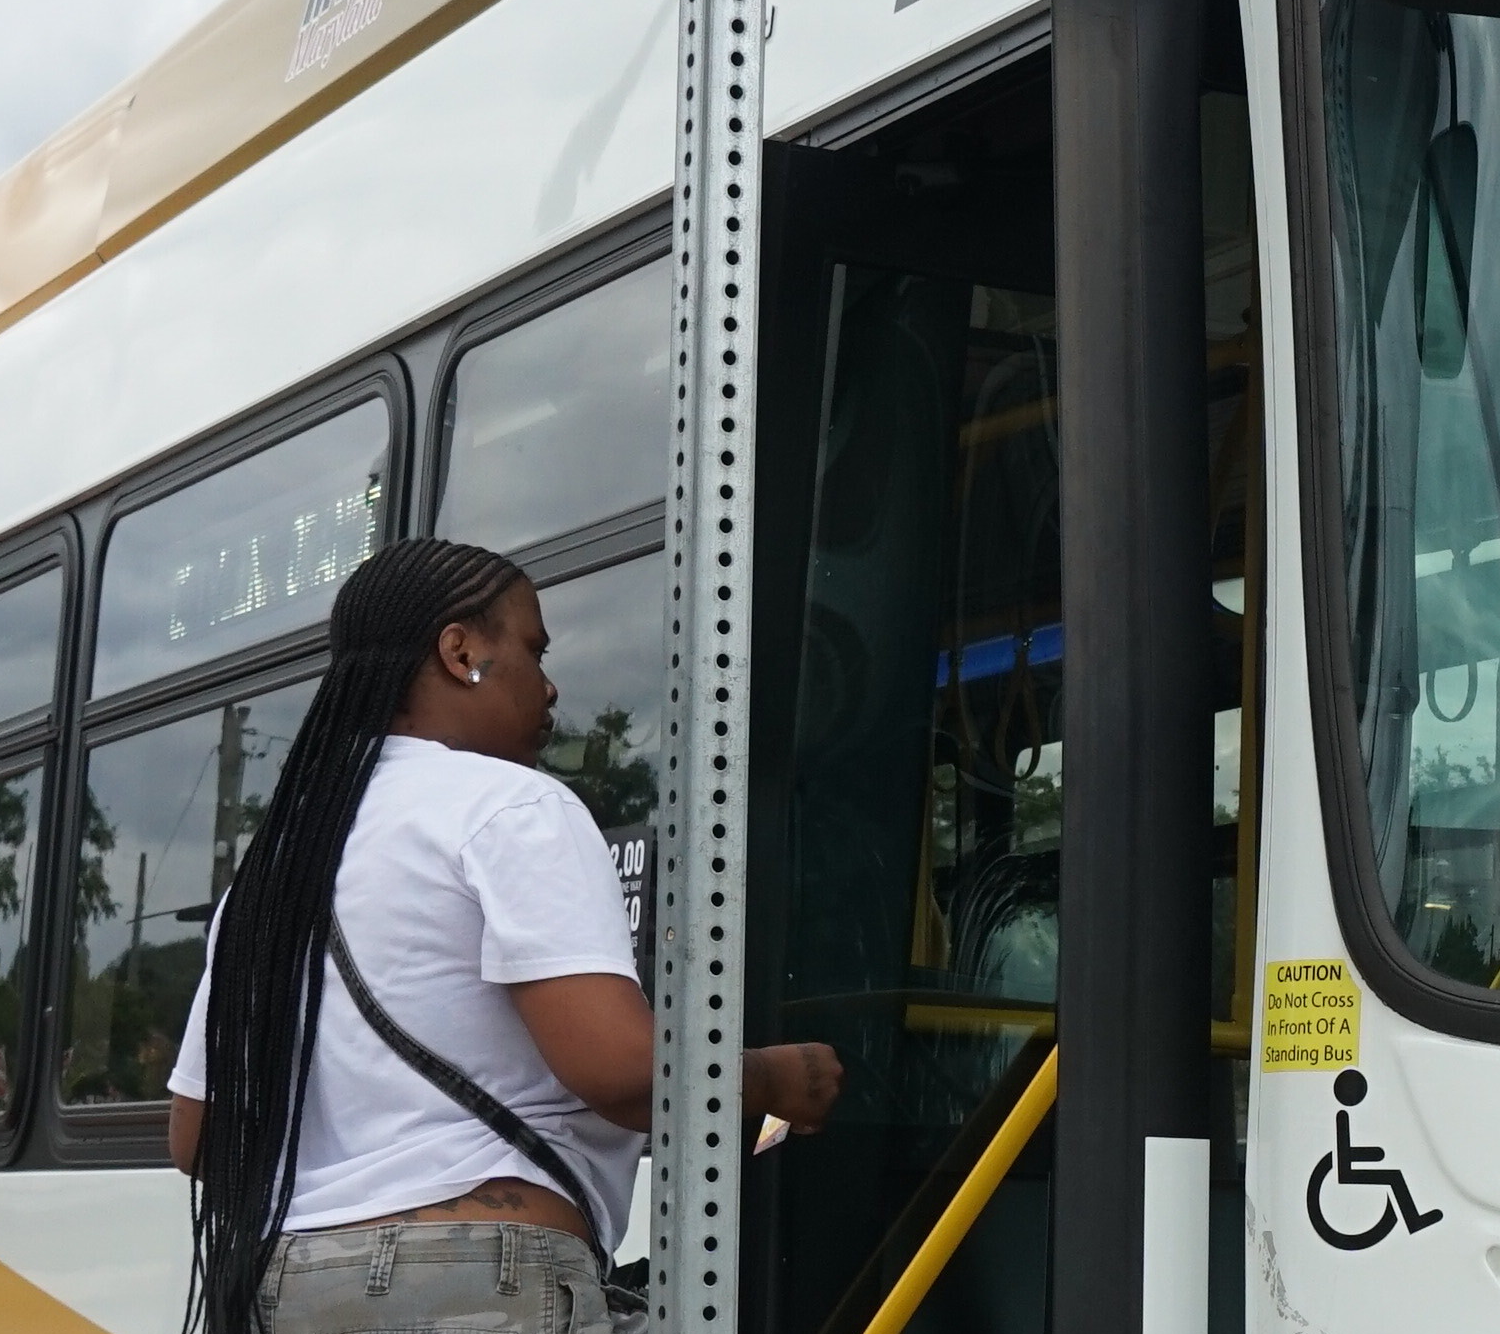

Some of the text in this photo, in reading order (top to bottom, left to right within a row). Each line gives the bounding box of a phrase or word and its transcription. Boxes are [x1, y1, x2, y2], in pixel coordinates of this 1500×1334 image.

[1277, 964, 1342, 983] CAUTION
[1268, 991, 1354, 1010] Do Not Cross
[1267, 1017, 1351, 1036] In Front Of A
[1265, 1044, 1353, 1066] Standing Bus
